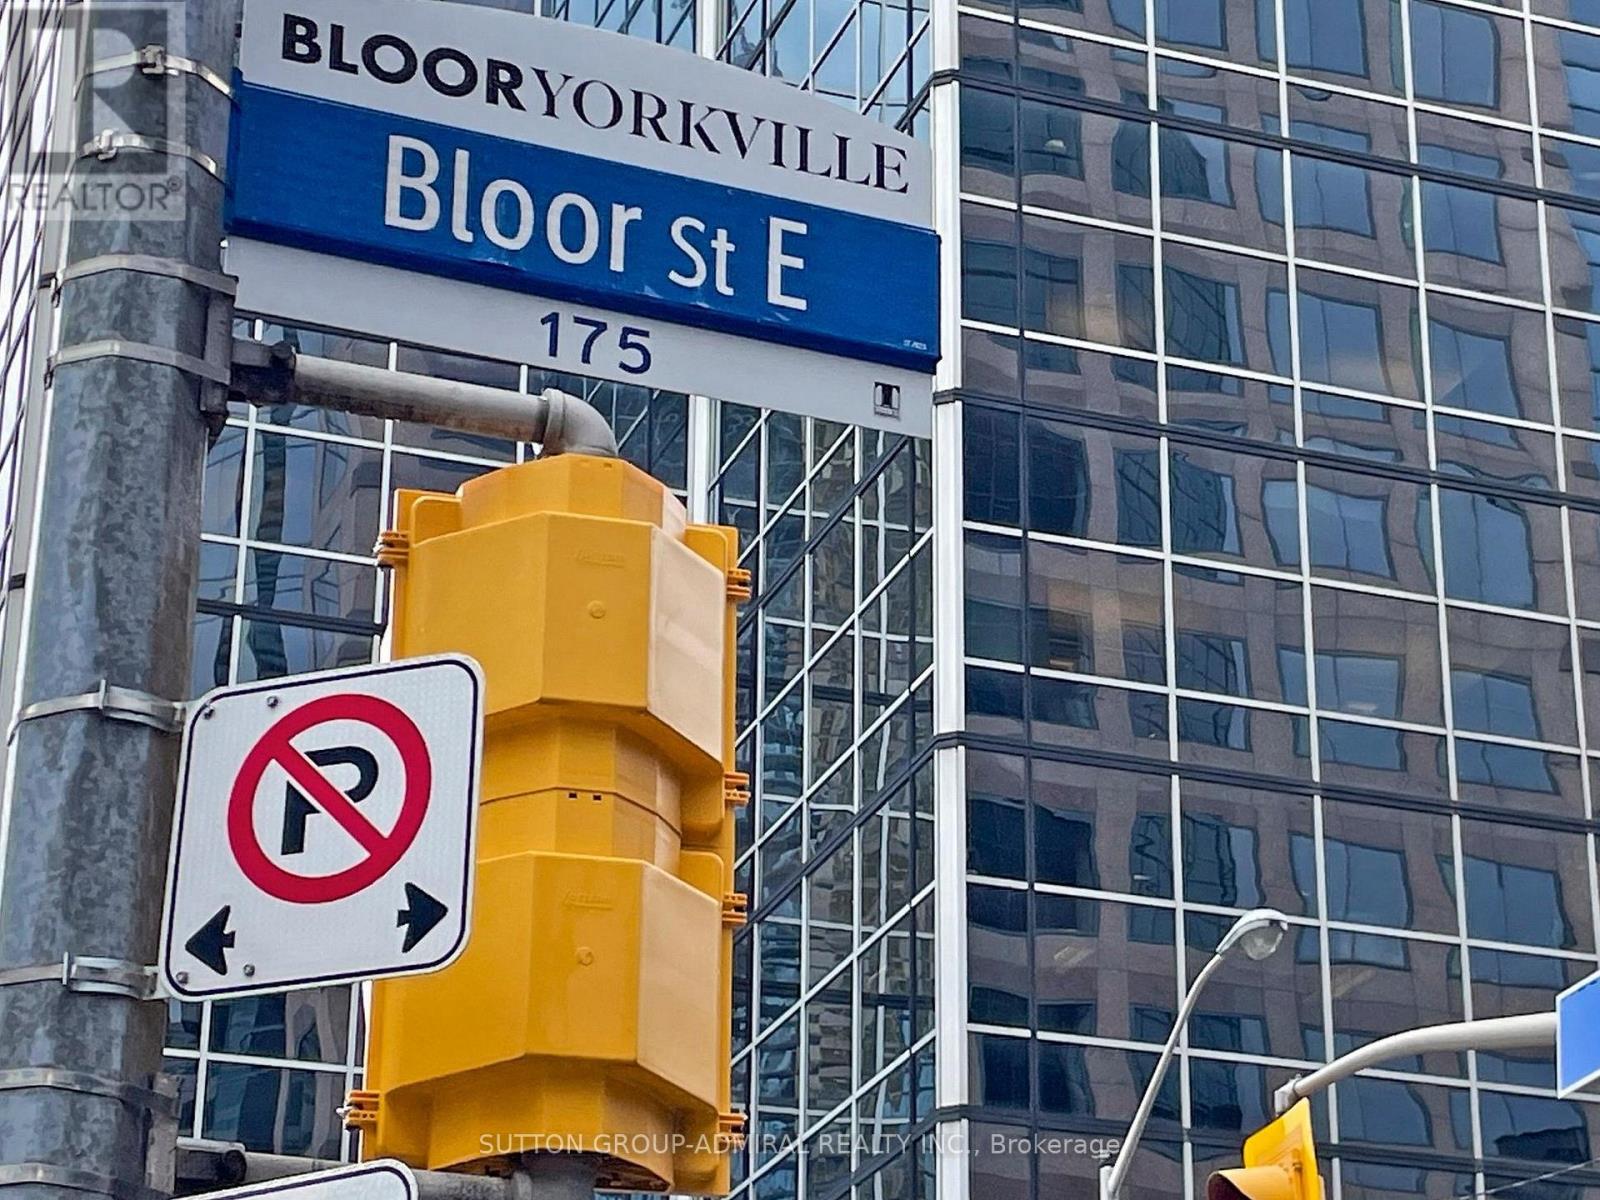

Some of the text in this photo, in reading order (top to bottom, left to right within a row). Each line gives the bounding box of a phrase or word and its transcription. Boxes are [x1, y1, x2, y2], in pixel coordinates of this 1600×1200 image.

[384, 134, 808, 312] Bloor St E
[540, 311, 652, 375] 175
